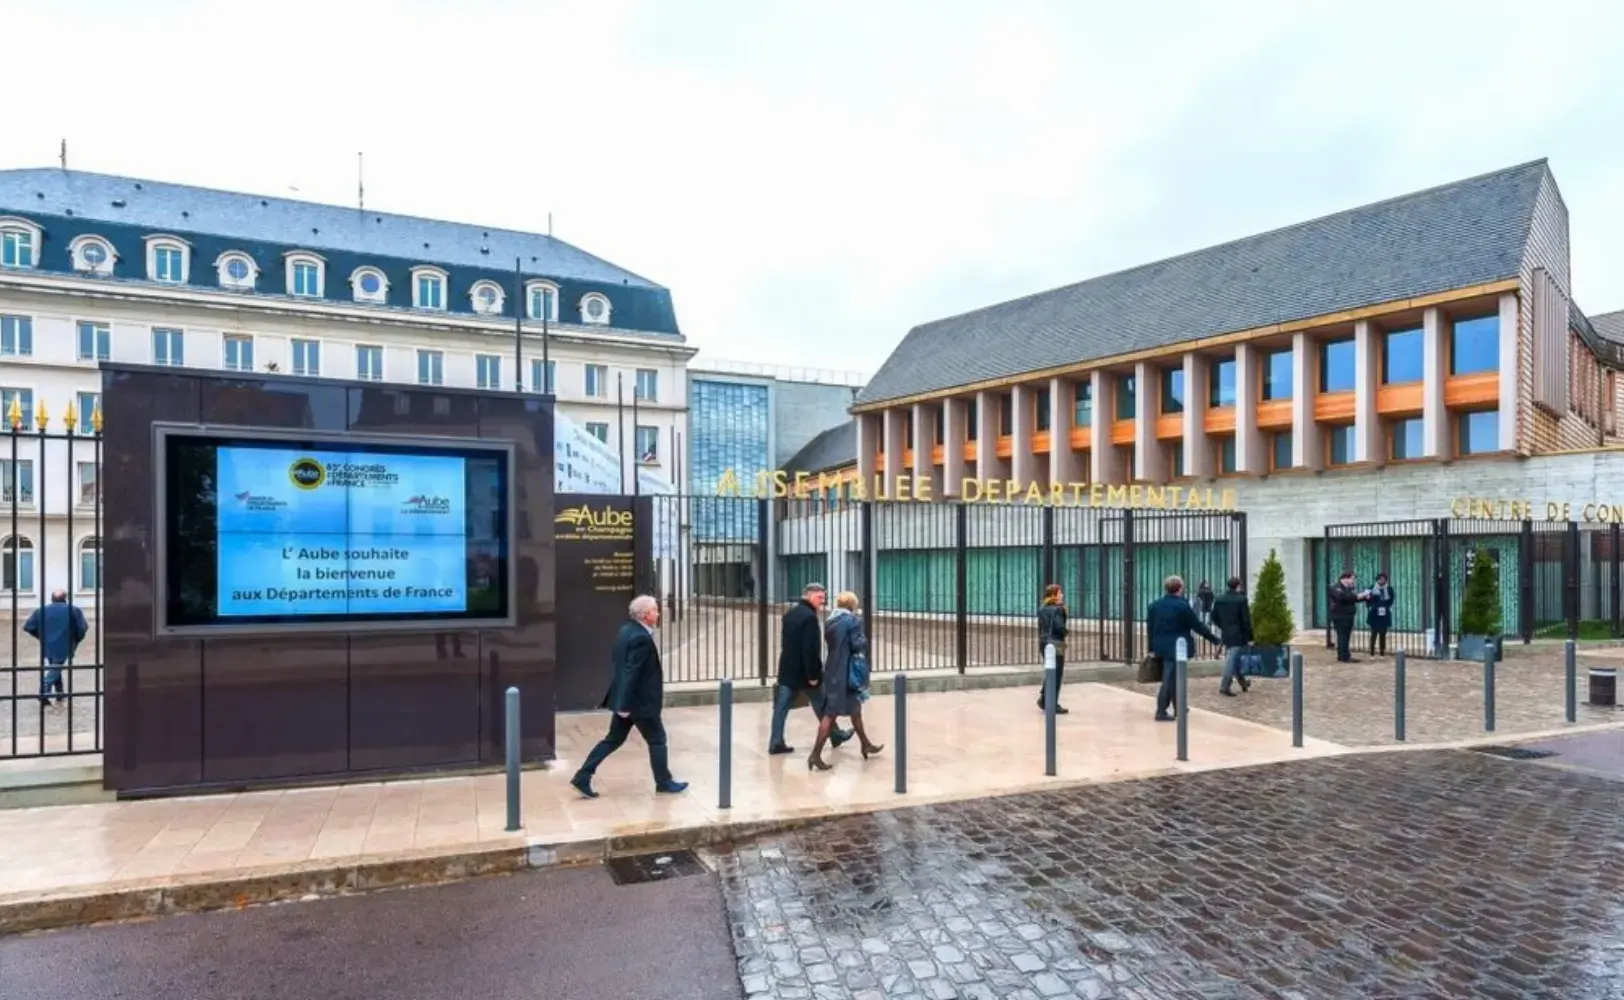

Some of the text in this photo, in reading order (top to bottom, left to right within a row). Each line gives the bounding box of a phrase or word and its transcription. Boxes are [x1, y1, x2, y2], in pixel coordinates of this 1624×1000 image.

[418, 494, 450, 509] Aube
[961, 478, 1237, 510] DEPARTEMENTALE
[577, 504, 633, 526] Aube
[1451, 498, 1532, 520] CENTRE
[1547, 501, 1571, 522] DE
[298, 547, 340, 560] Aube
[344, 547, 409, 560] souhaite
[297, 566, 396, 580] la bienvenue
[232, 586, 453, 602] aux Départements de France
